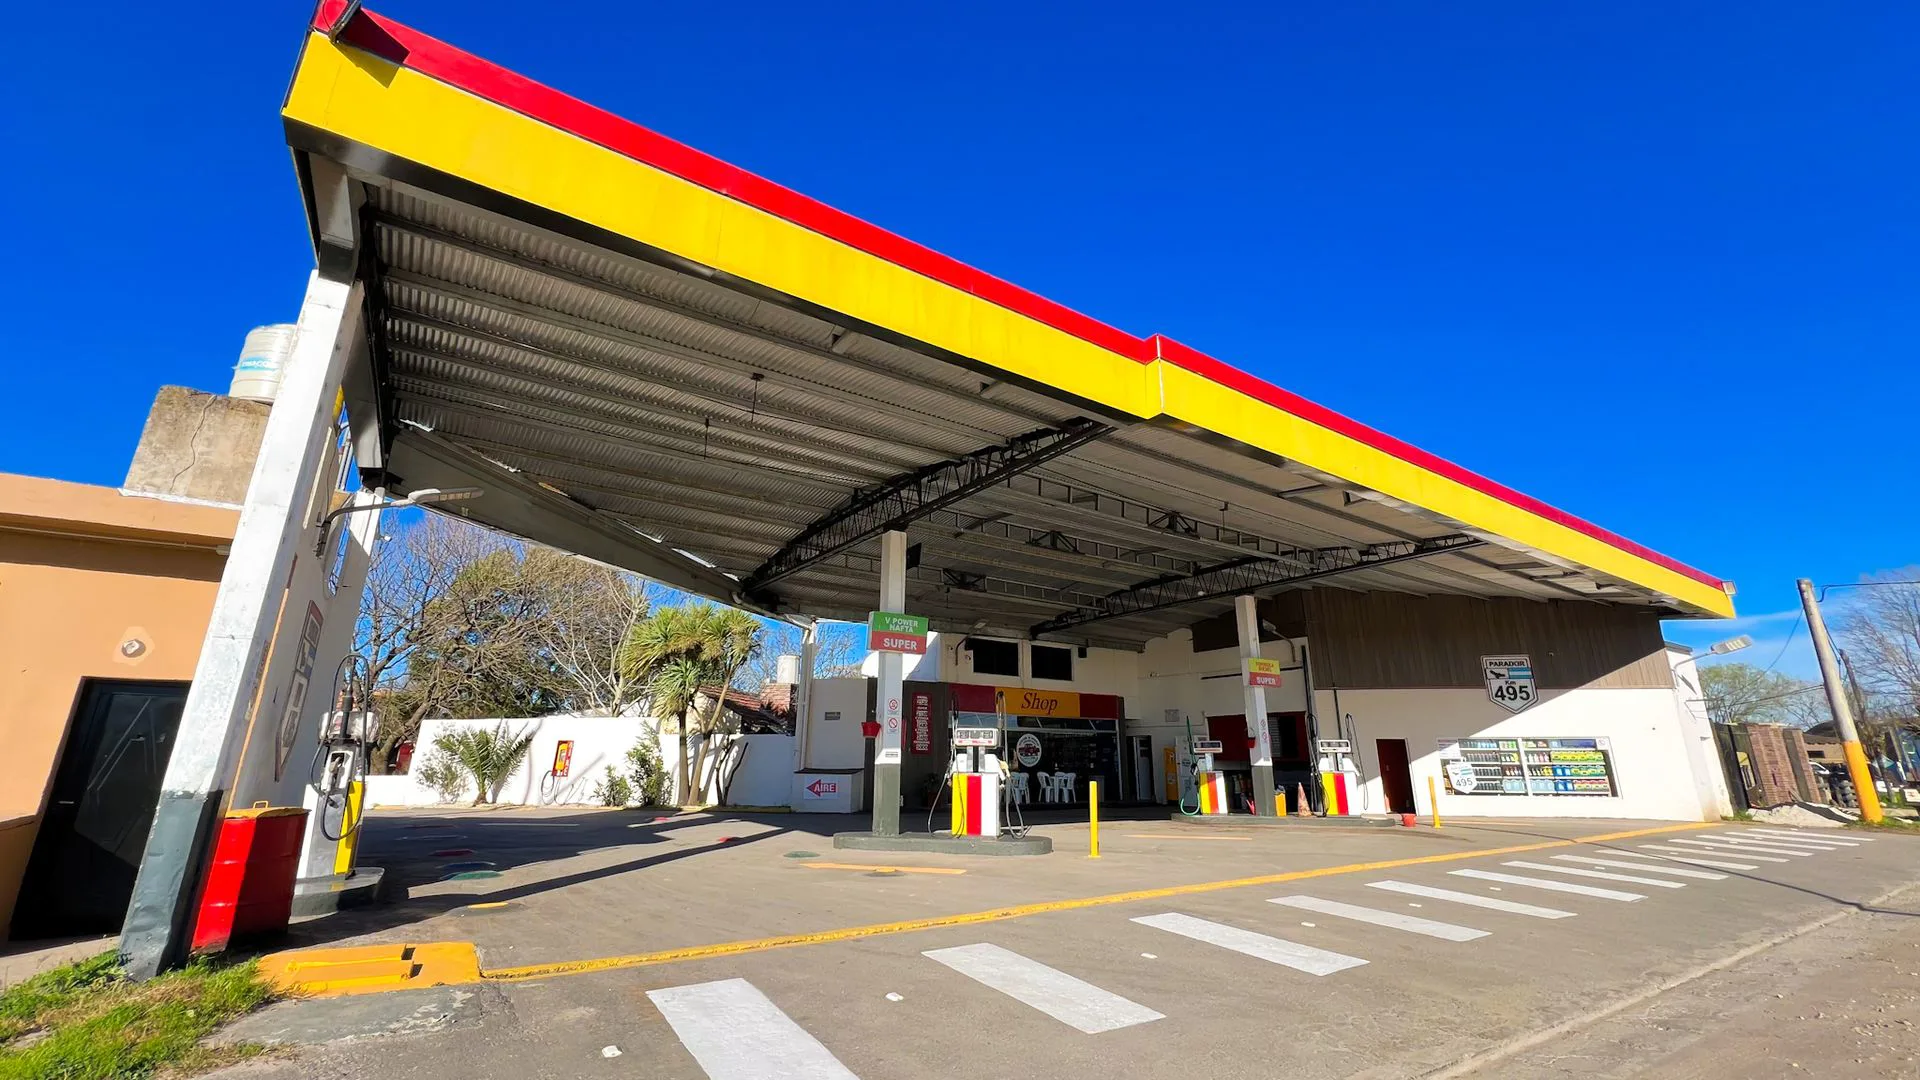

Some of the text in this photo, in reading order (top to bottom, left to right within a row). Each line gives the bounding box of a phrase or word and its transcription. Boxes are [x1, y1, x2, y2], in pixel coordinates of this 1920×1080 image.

[885, 617, 918, 627] V POWER
[889, 624, 914, 633] NAFTA
[883, 638, 917, 651] SUPER
[1256, 676, 1276, 685] SUPER
[1495, 685, 1530, 701] 495
[1021, 692, 1058, 714] Shop
[1455, 777, 1473, 787] 495
[814, 783, 835, 792] AIRE
